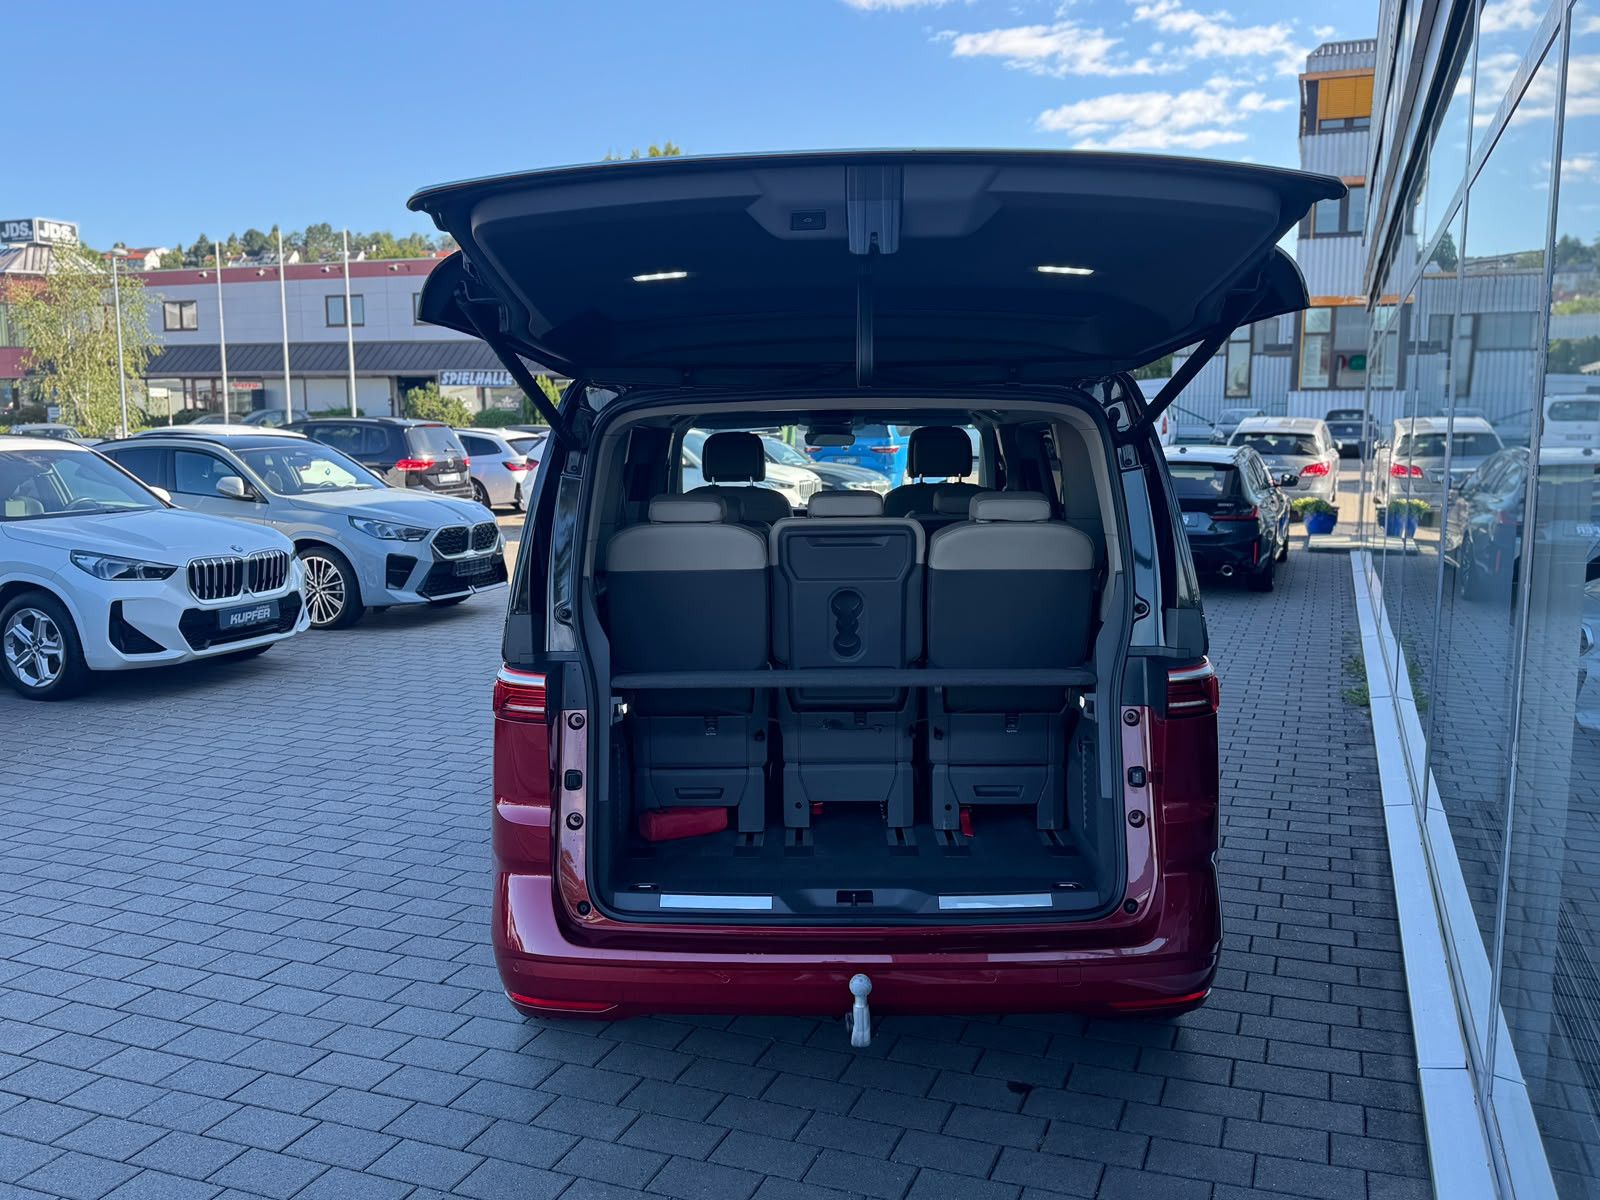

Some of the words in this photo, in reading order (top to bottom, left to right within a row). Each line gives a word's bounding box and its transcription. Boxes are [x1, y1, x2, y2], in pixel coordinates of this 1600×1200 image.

[1, 222, 33, 238] JDS.
[441, 371, 513, 385] SPIELHALLE
[230, 608, 270, 625] KUPFER
